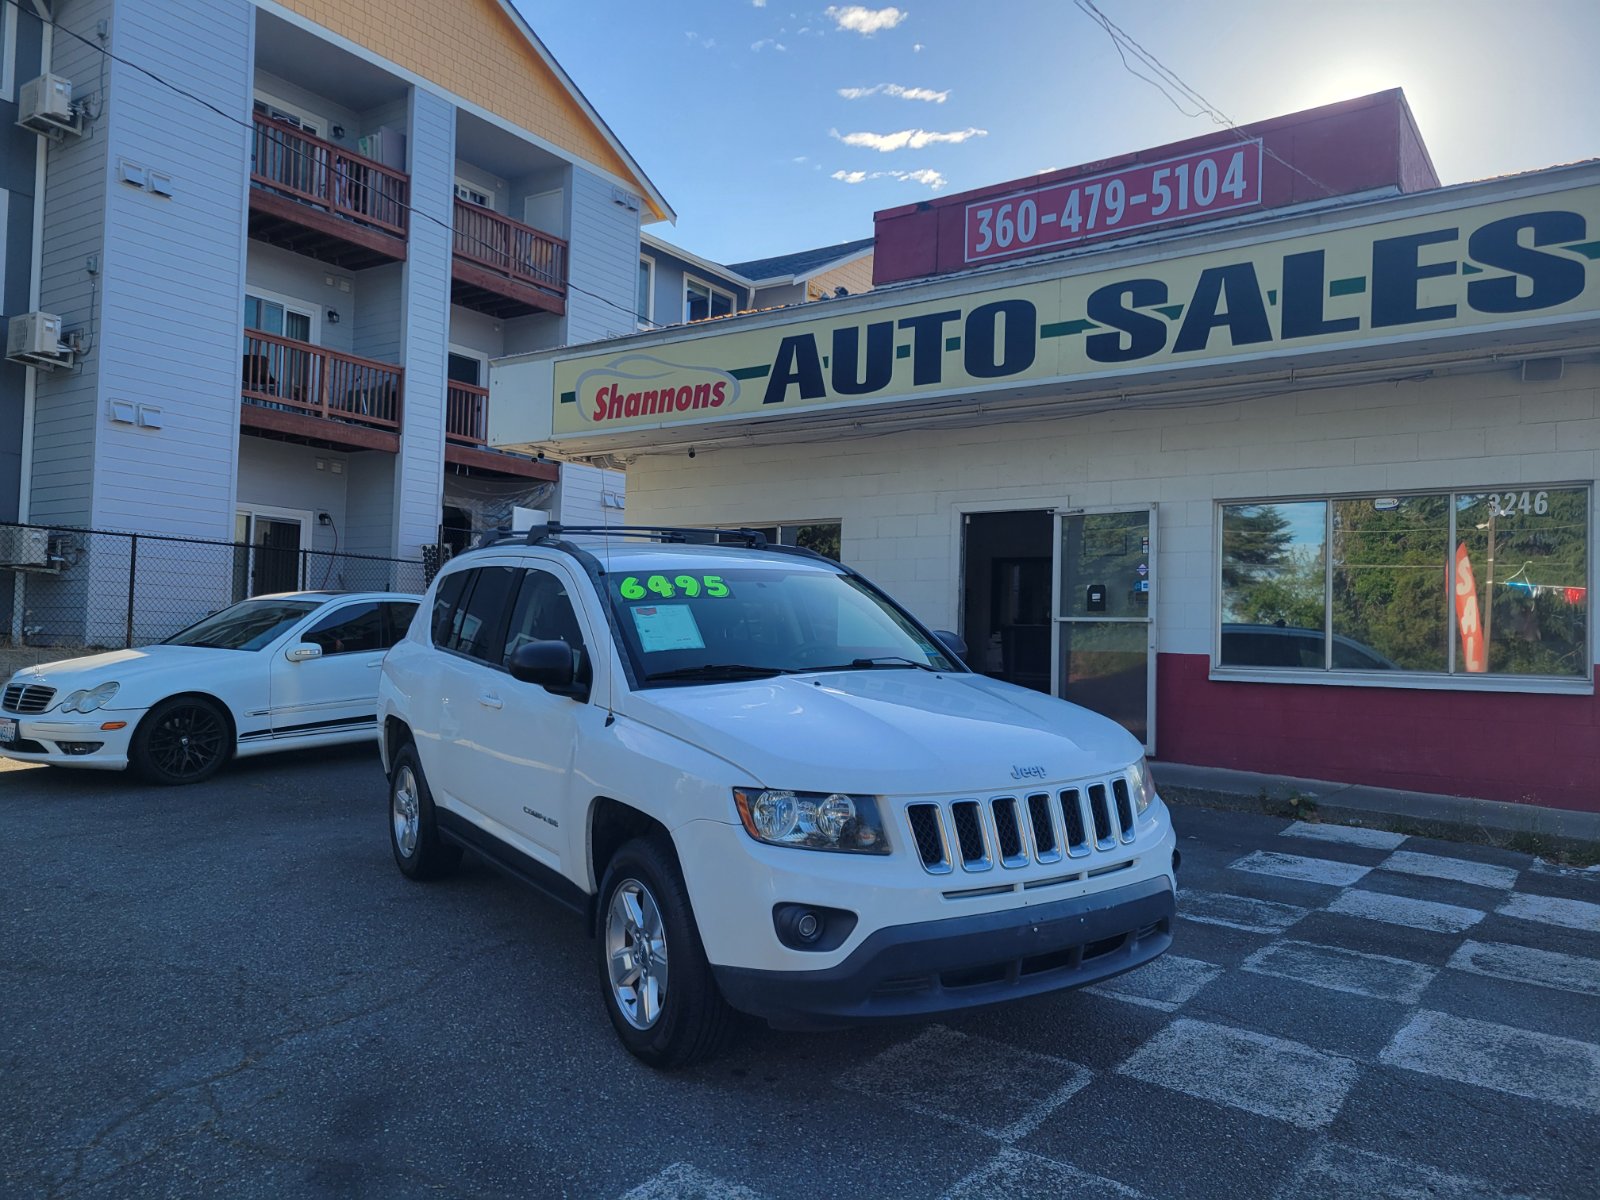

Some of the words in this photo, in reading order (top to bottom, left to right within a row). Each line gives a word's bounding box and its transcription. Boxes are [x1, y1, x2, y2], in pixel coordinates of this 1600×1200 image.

[975, 151, 1247, 253] 360-479-5104
[592, 380, 728, 422] Shannons
[762, 298, 1038, 405] AUTO
[1085, 210, 1587, 363] SALES
[1488, 491, 1549, 517] 3246
[620, 575, 730, 600] 6495
[1010, 765, 1047, 780] Jeep
